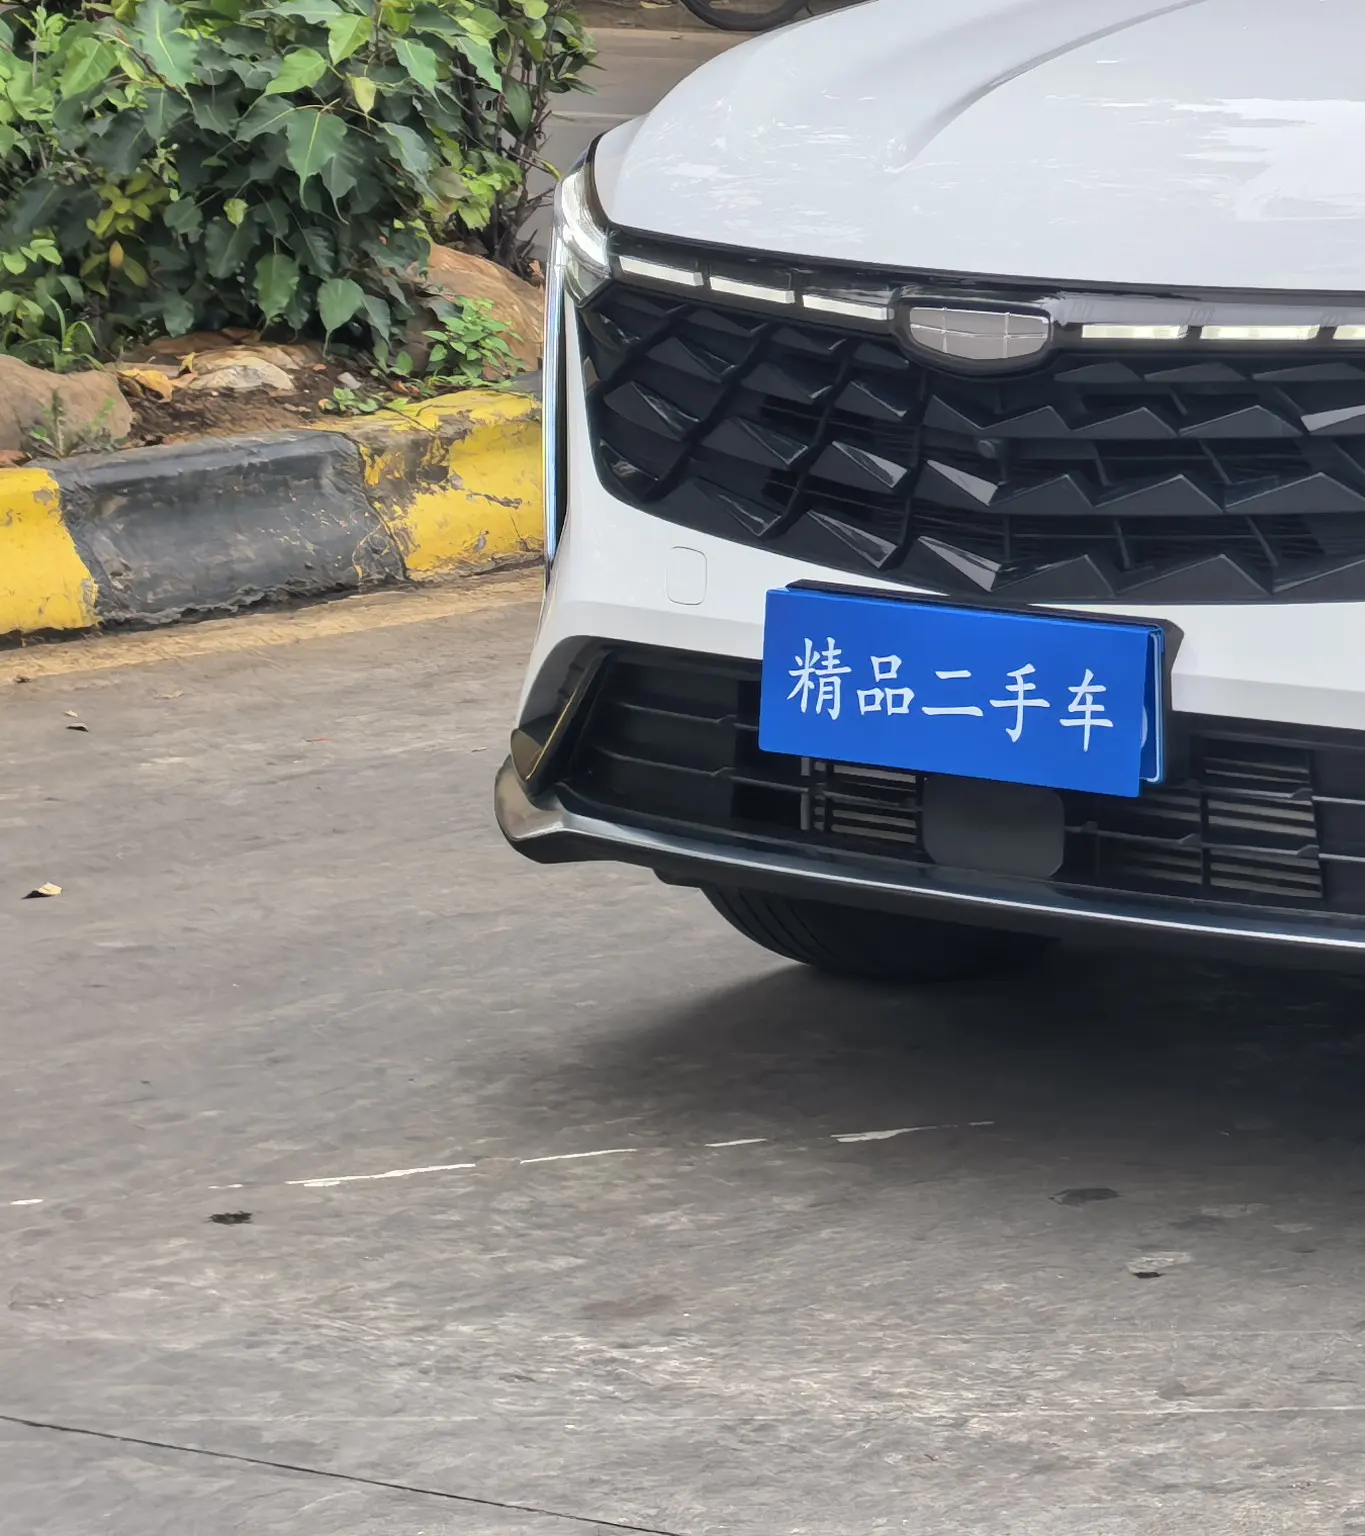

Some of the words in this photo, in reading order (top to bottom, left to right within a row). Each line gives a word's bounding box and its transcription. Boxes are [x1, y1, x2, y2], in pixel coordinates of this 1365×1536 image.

[787, 636, 1114, 752] 精品二手车
